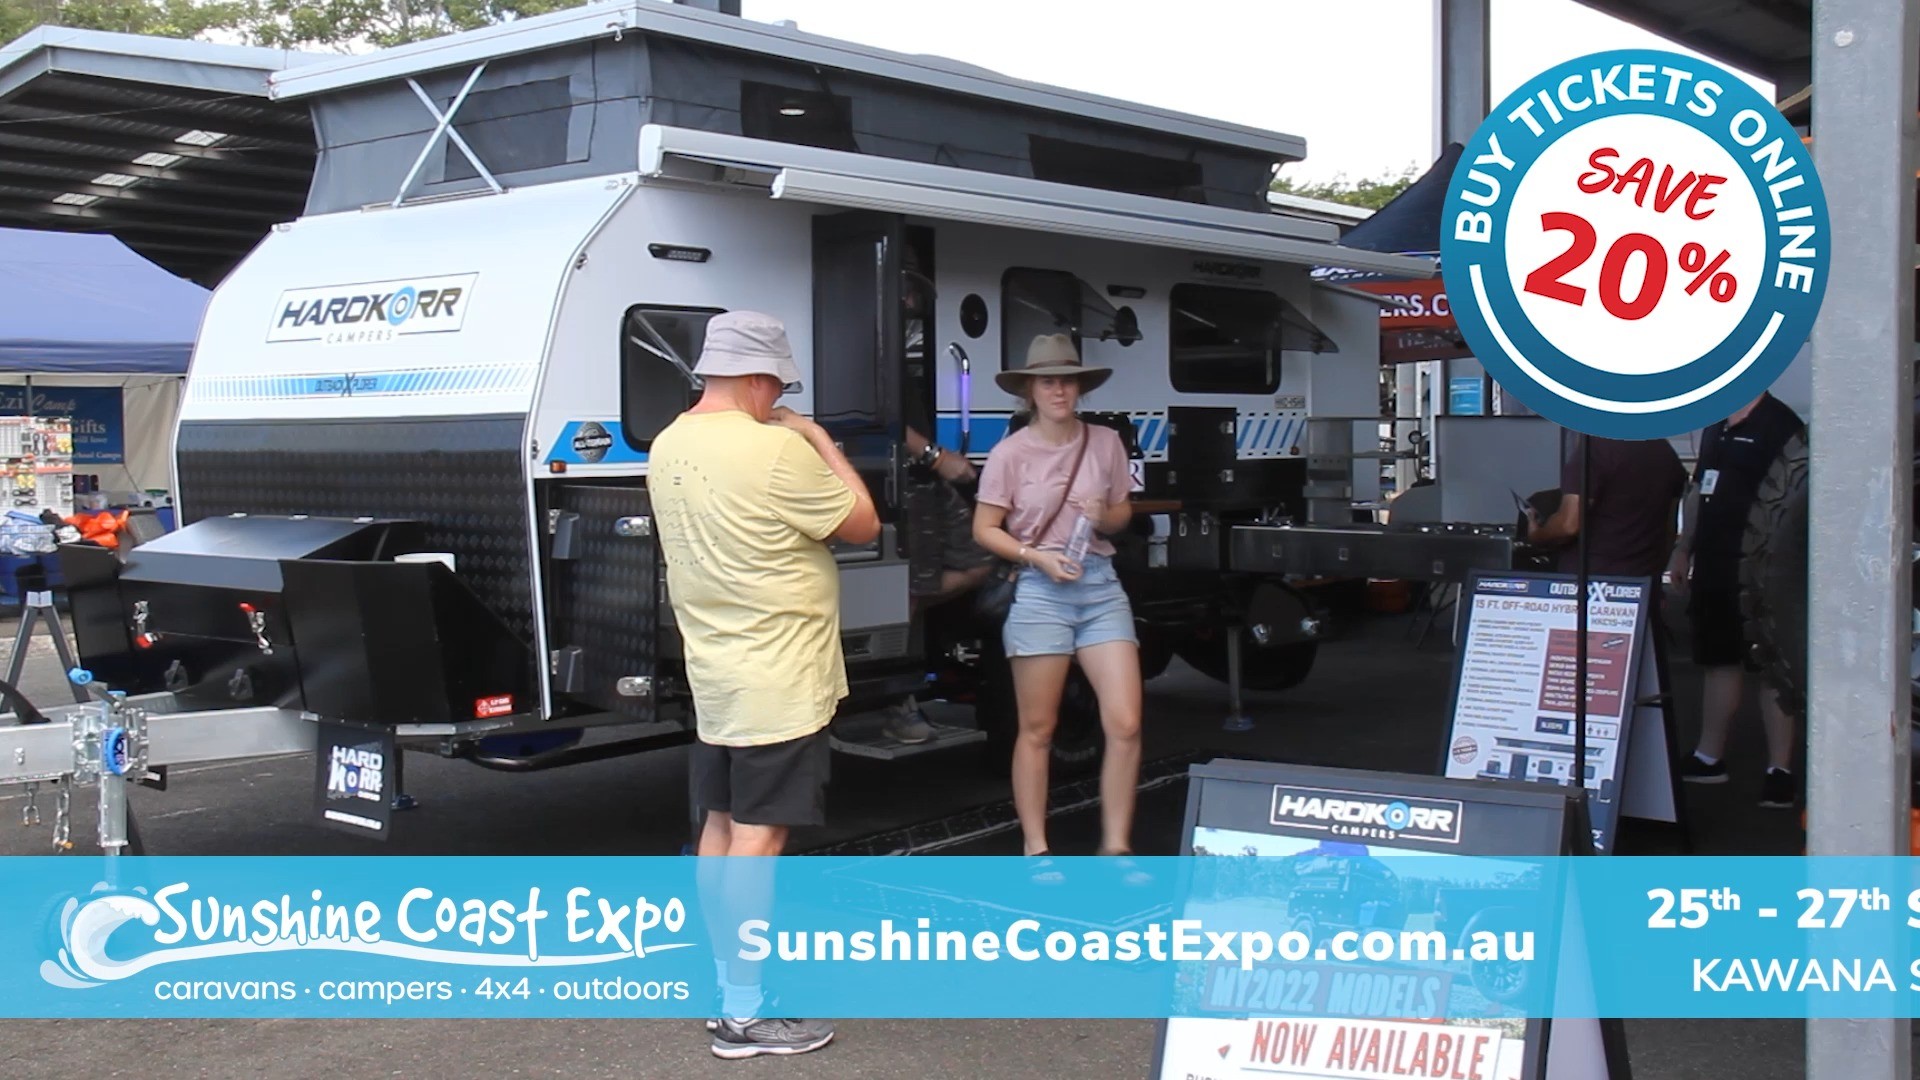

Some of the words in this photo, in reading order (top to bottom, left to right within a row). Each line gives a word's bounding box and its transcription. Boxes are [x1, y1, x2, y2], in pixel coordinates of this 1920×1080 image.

[278, 286, 462, 328] HARDKORR
[327, 330, 392, 344] CAMPERS
[1502, 602, 1550, 613] OFF-ROAD
[1590, 606, 1635, 618] CARAVAN
[332, 745, 383, 770] HARD
[1279, 795, 1454, 832] HARDKORR
[1331, 824, 1396, 840] CAMPERS
[1210, 965, 1320, 1013] MY2022
[1327, 971, 1442, 1020] MODELS
[1250, 1020, 1318, 1066] NOW
[1325, 1026, 1491, 1080] AVAILABLE
